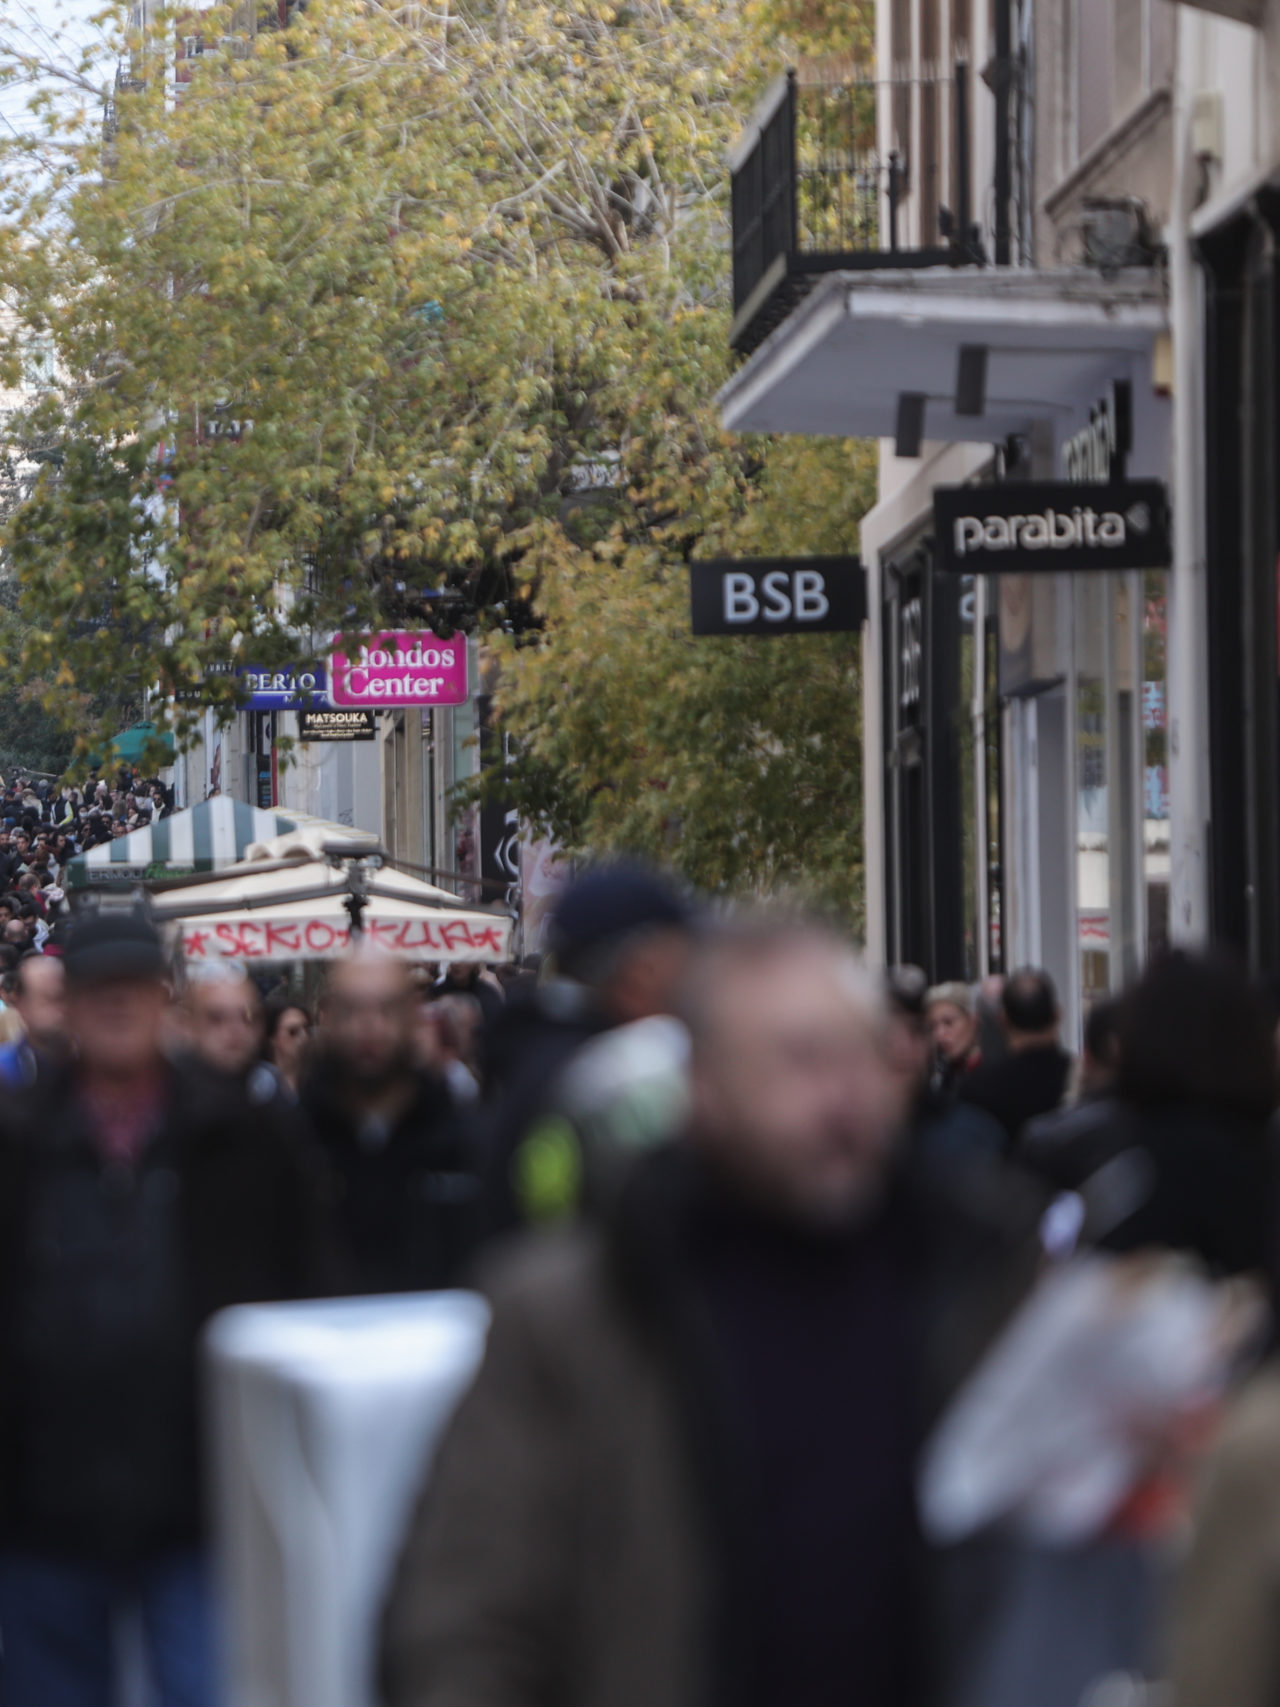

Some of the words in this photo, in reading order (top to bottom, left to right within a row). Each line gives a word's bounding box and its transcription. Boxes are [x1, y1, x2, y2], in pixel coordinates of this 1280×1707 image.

[954, 506, 1126, 557] parabita
[724, 569, 830, 624] BSB
[343, 667, 445, 697] Center
[305, 712, 368, 724] MATSOUKA
